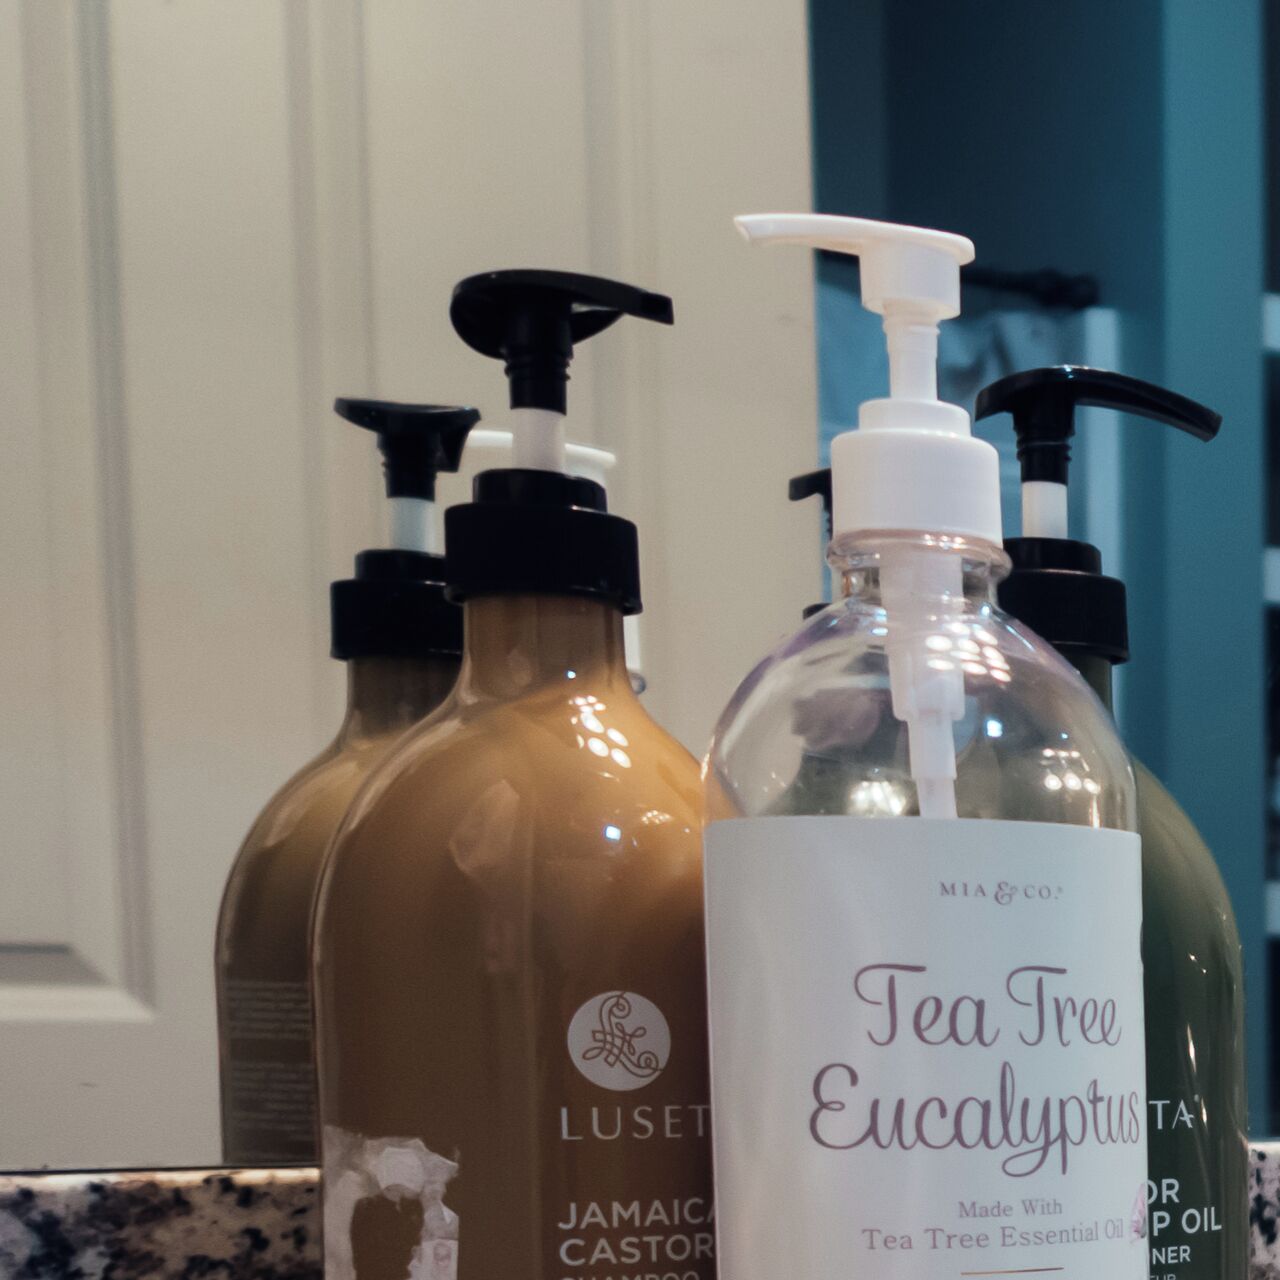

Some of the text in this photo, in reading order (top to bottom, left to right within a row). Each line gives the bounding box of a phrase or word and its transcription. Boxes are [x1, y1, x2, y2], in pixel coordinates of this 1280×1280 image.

[939, 881, 987, 897] MIA
[994, 880, 1018, 906] &
[854, 963, 1122, 1047] Tea Tree
[560, 1105, 711, 1140] LUSET
[809, 1061, 1140, 1178] Eucalyptus
[958, 1198, 1063, 1219] Made With
[1181, 1206, 1222, 1234] OIL
[559, 1233, 714, 1266] CASTOR
[862, 1218, 1124, 1250] Tea Tree Essential Oil
